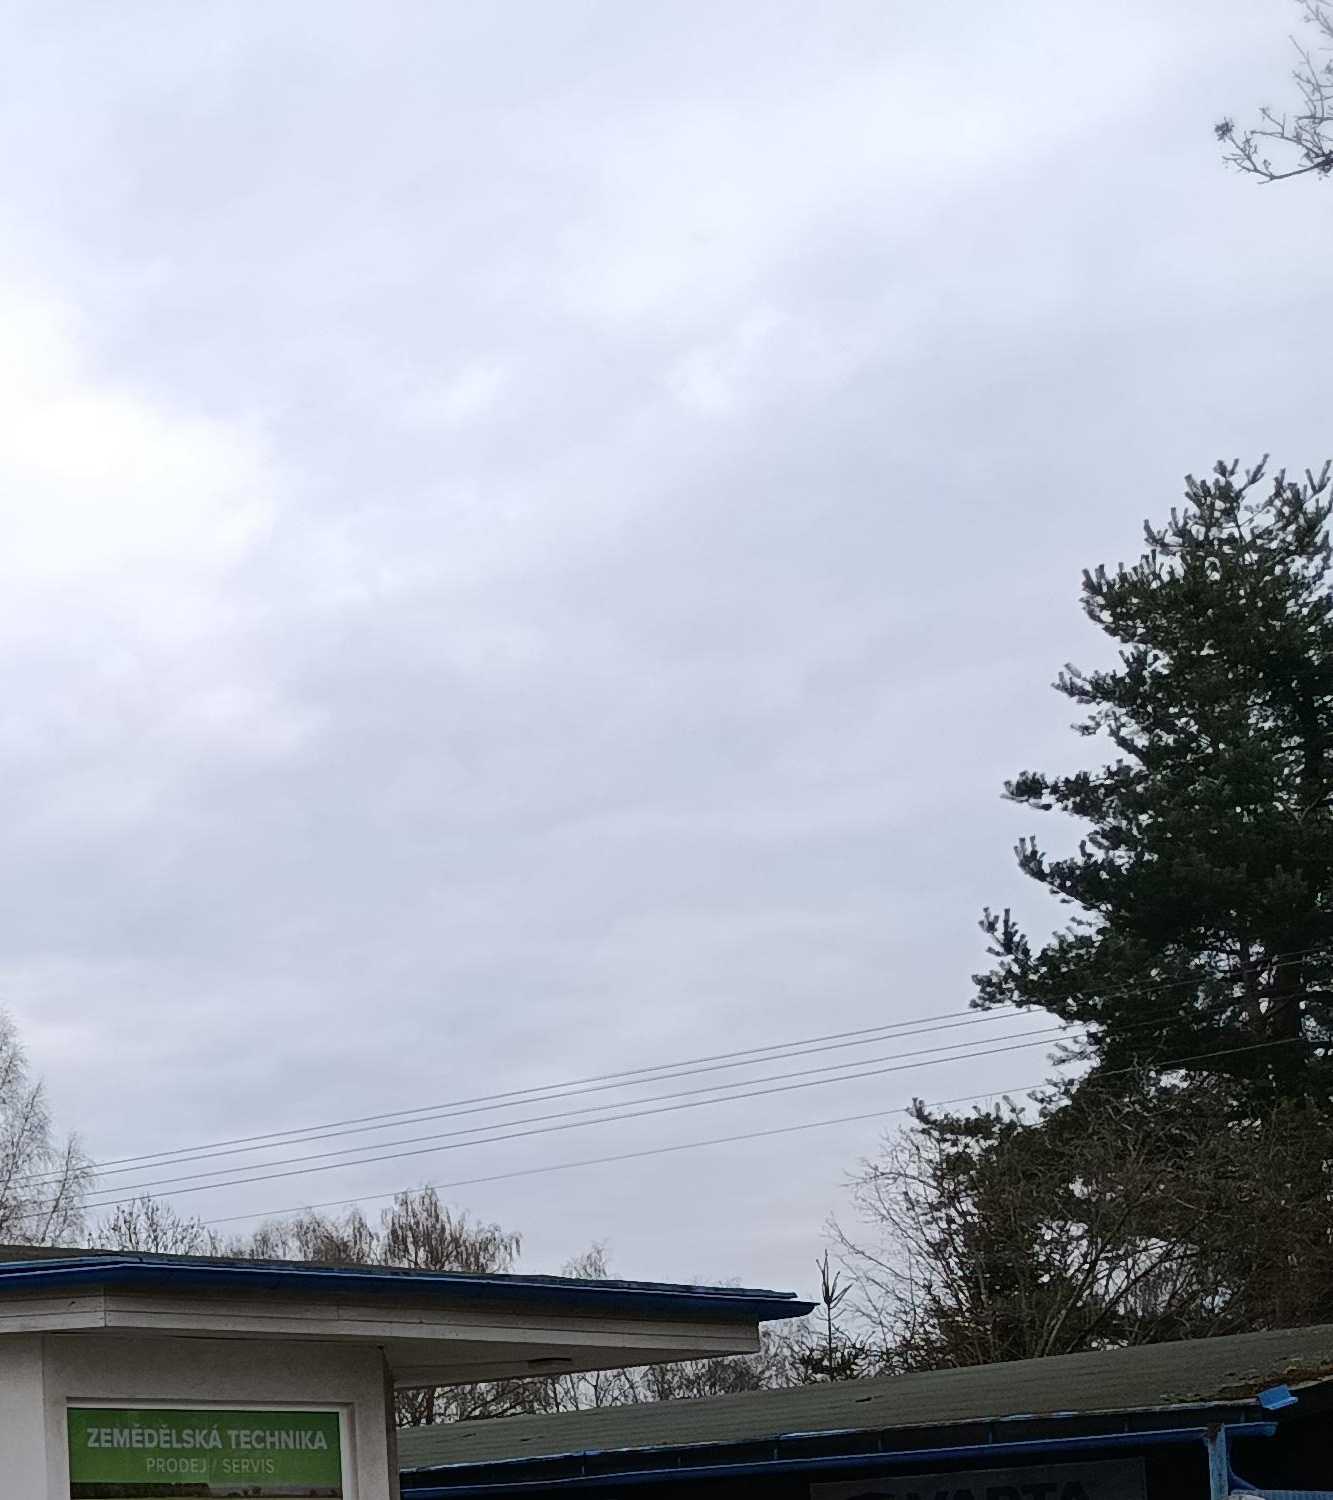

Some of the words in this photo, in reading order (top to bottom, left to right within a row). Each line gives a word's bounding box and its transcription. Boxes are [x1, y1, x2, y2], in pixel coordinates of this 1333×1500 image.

[87, 1424, 222, 1449] ZEMĚDĚLSKÁ
[227, 1430, 327, 1450] TECHNIKA
[146, 1457, 207, 1473] PRODEJ
[222, 1458, 275, 1473] SERVIS
